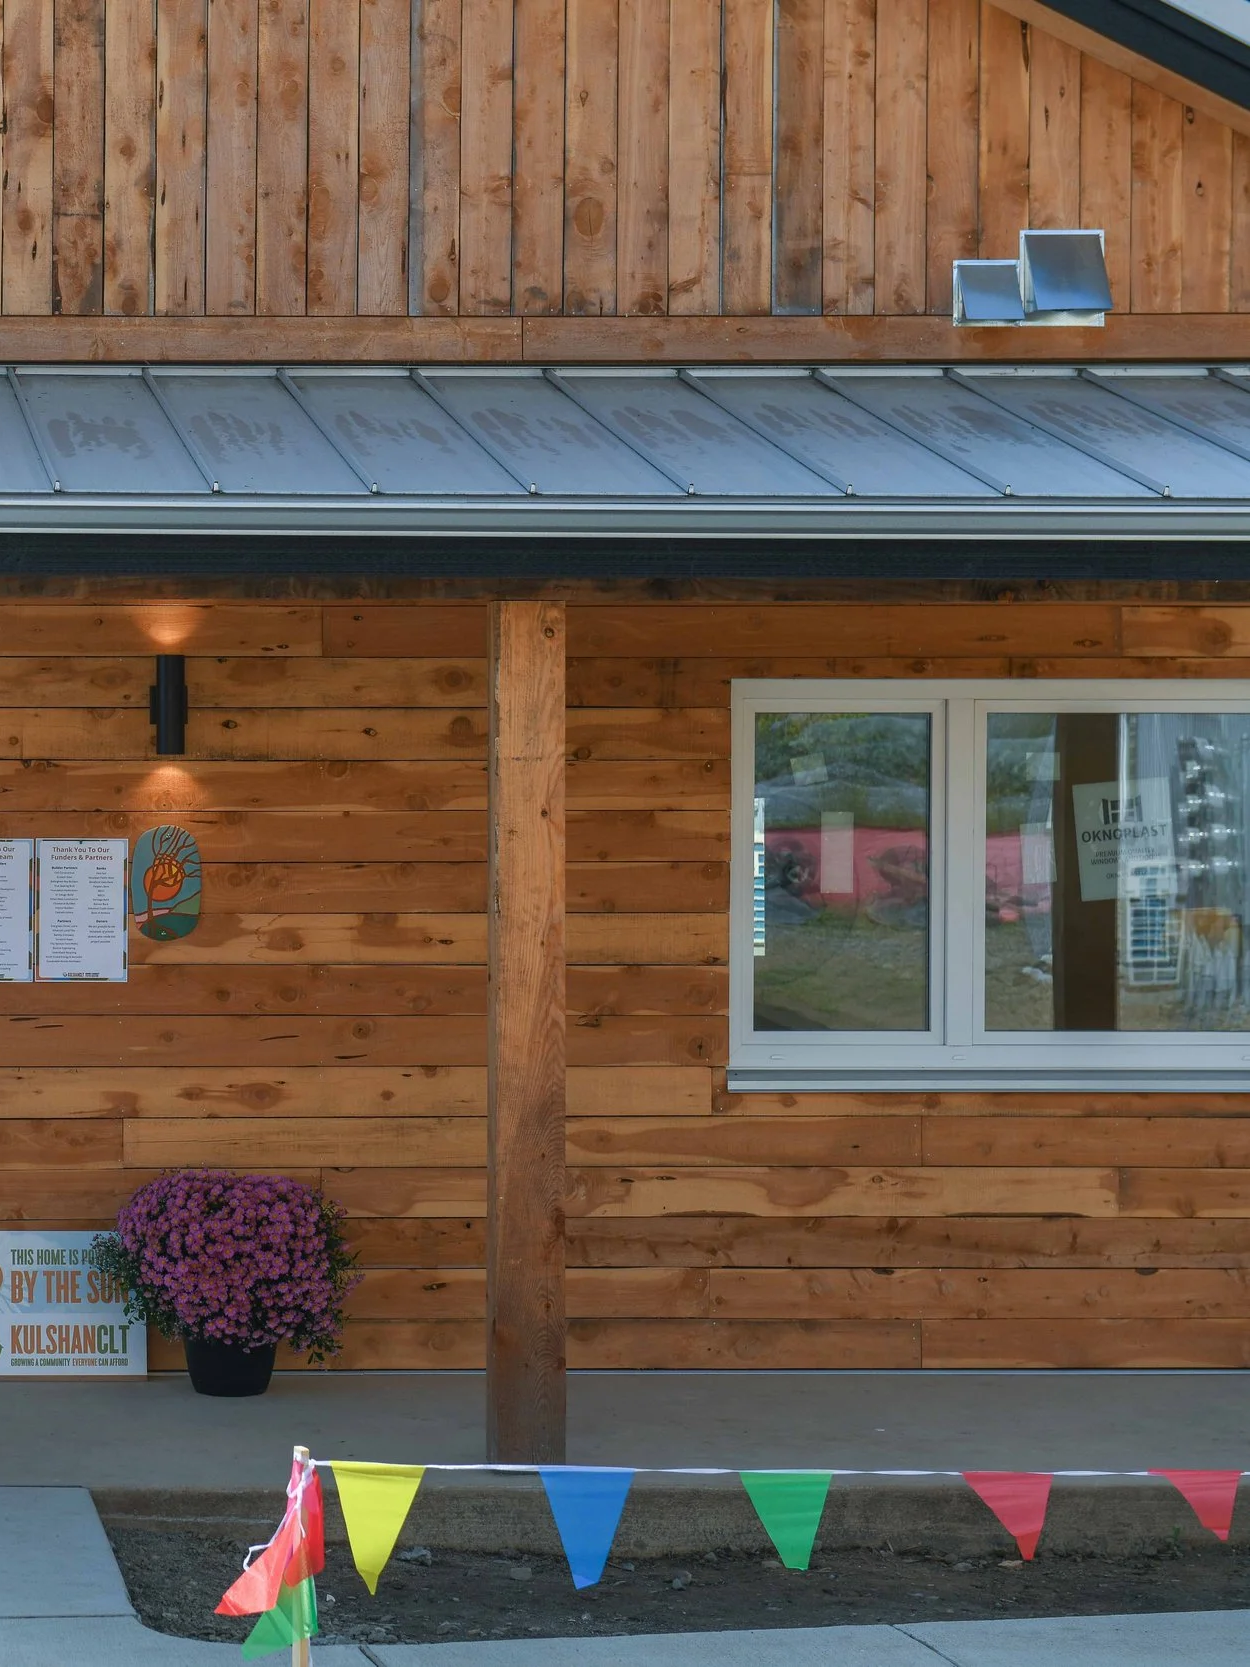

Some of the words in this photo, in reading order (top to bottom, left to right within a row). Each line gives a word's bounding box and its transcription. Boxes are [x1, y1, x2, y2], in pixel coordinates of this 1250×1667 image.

[1081, 823, 1167, 843] OKNOPLAST
[1090, 857, 1124, 866] WINDOW
[11, 1249, 34, 1265] THIS
[36, 1249, 66, 1265] HOME
[68, 1249, 79, 1265] IS
[11, 1270, 38, 1304] BY
[43, 1270, 82, 1304] THE
[11, 1324, 130, 1354] KULSHANCLT
[11, 1358, 35, 1367] GROWING
[35, 1358, 39, 1366] A
[39, 1358, 70, 1367] COMMUNITY
[72, 1358, 97, 1367] EVERYONE
[98, 1358, 108, 1367] CAN
[109, 1358, 129, 1367] AFFORD
